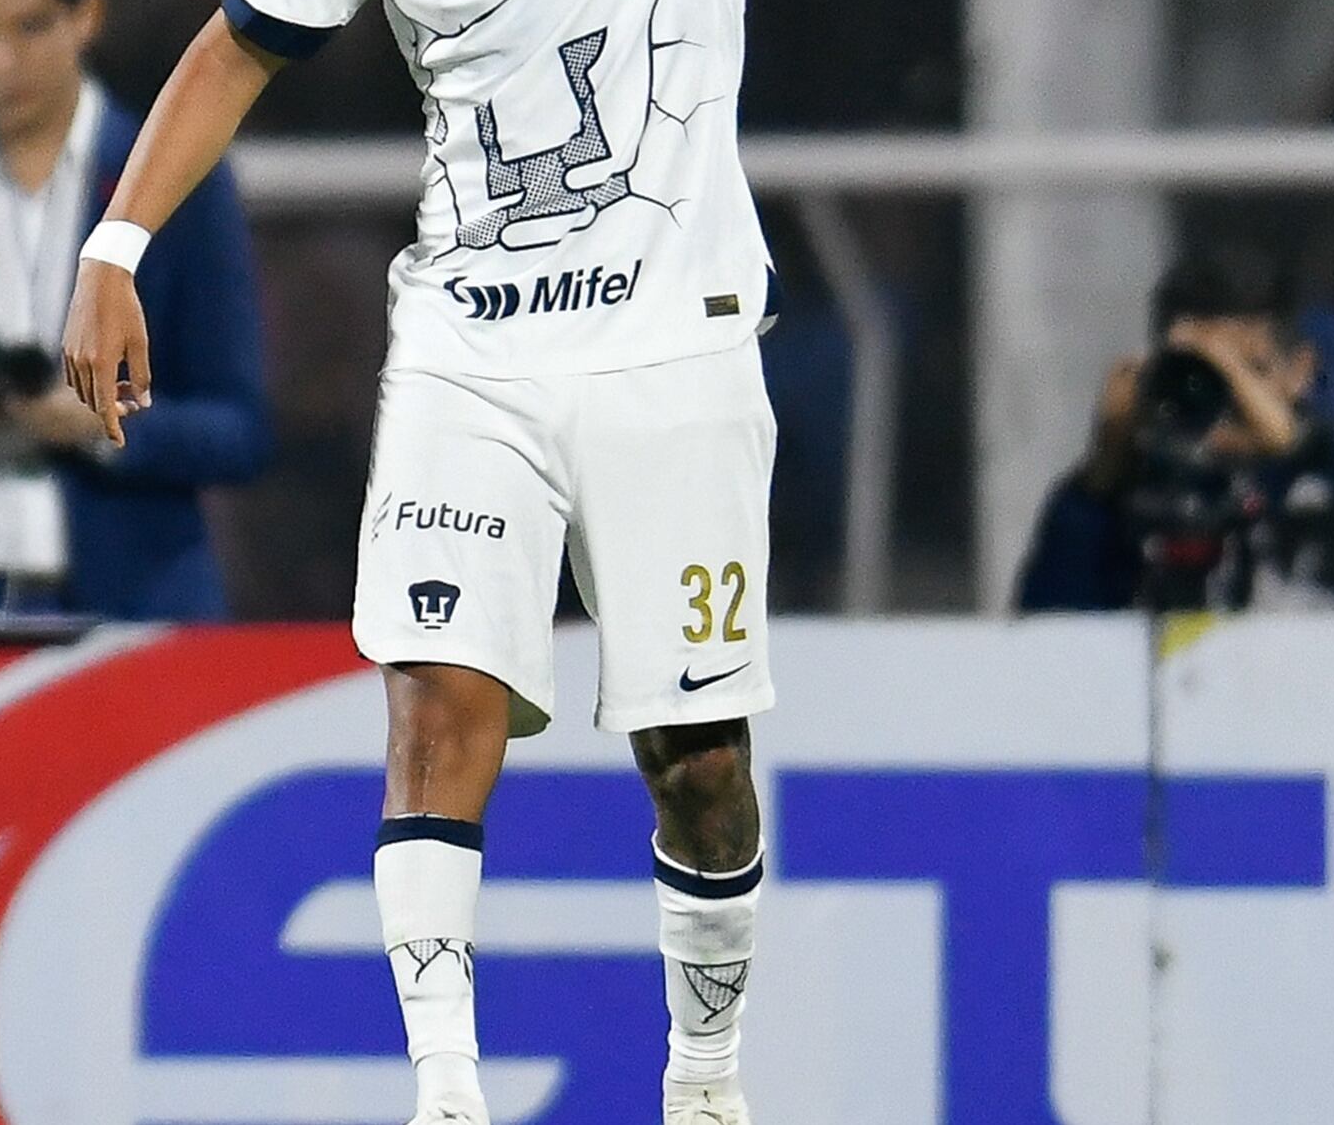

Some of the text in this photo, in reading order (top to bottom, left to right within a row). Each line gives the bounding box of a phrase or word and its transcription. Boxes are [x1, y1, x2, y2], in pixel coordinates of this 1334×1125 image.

[529, 259, 643, 314] Mifel
[395, 501, 506, 539] Futura
[680, 561, 747, 643] 32
